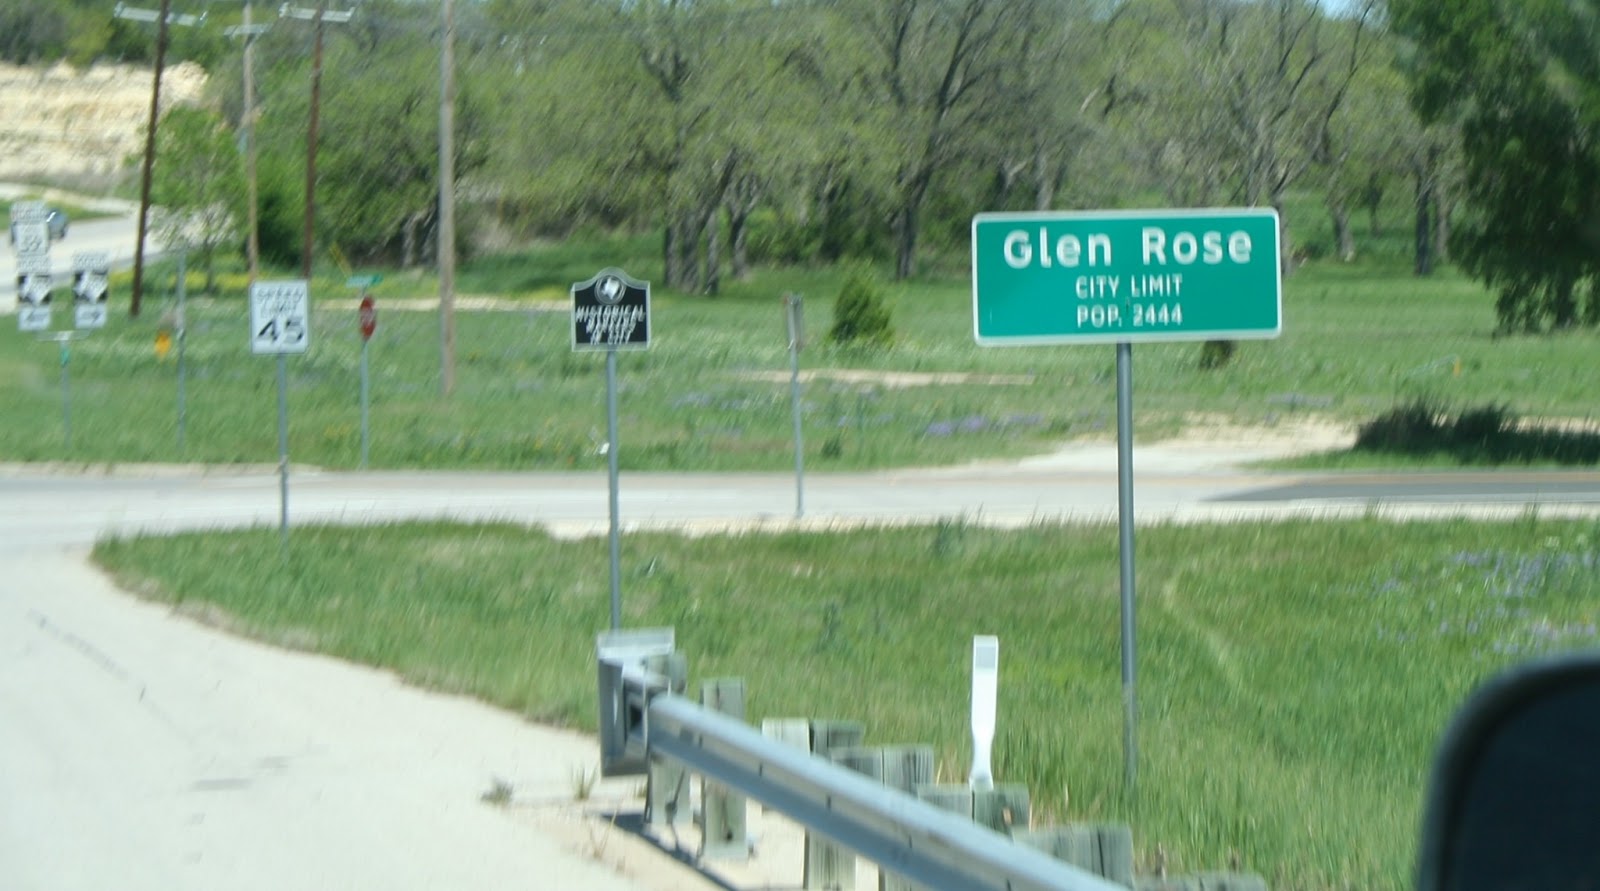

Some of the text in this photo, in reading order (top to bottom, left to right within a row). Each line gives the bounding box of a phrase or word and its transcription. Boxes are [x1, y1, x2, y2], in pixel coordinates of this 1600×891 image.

[1003, 226, 1252, 269] Glen Rose
[1075, 273, 1183, 299] CITY LIMIT
[575, 304, 646, 322] HISTORICAL
[1077, 302, 1183, 328] POP. 2444
[256, 318, 304, 342] 45
